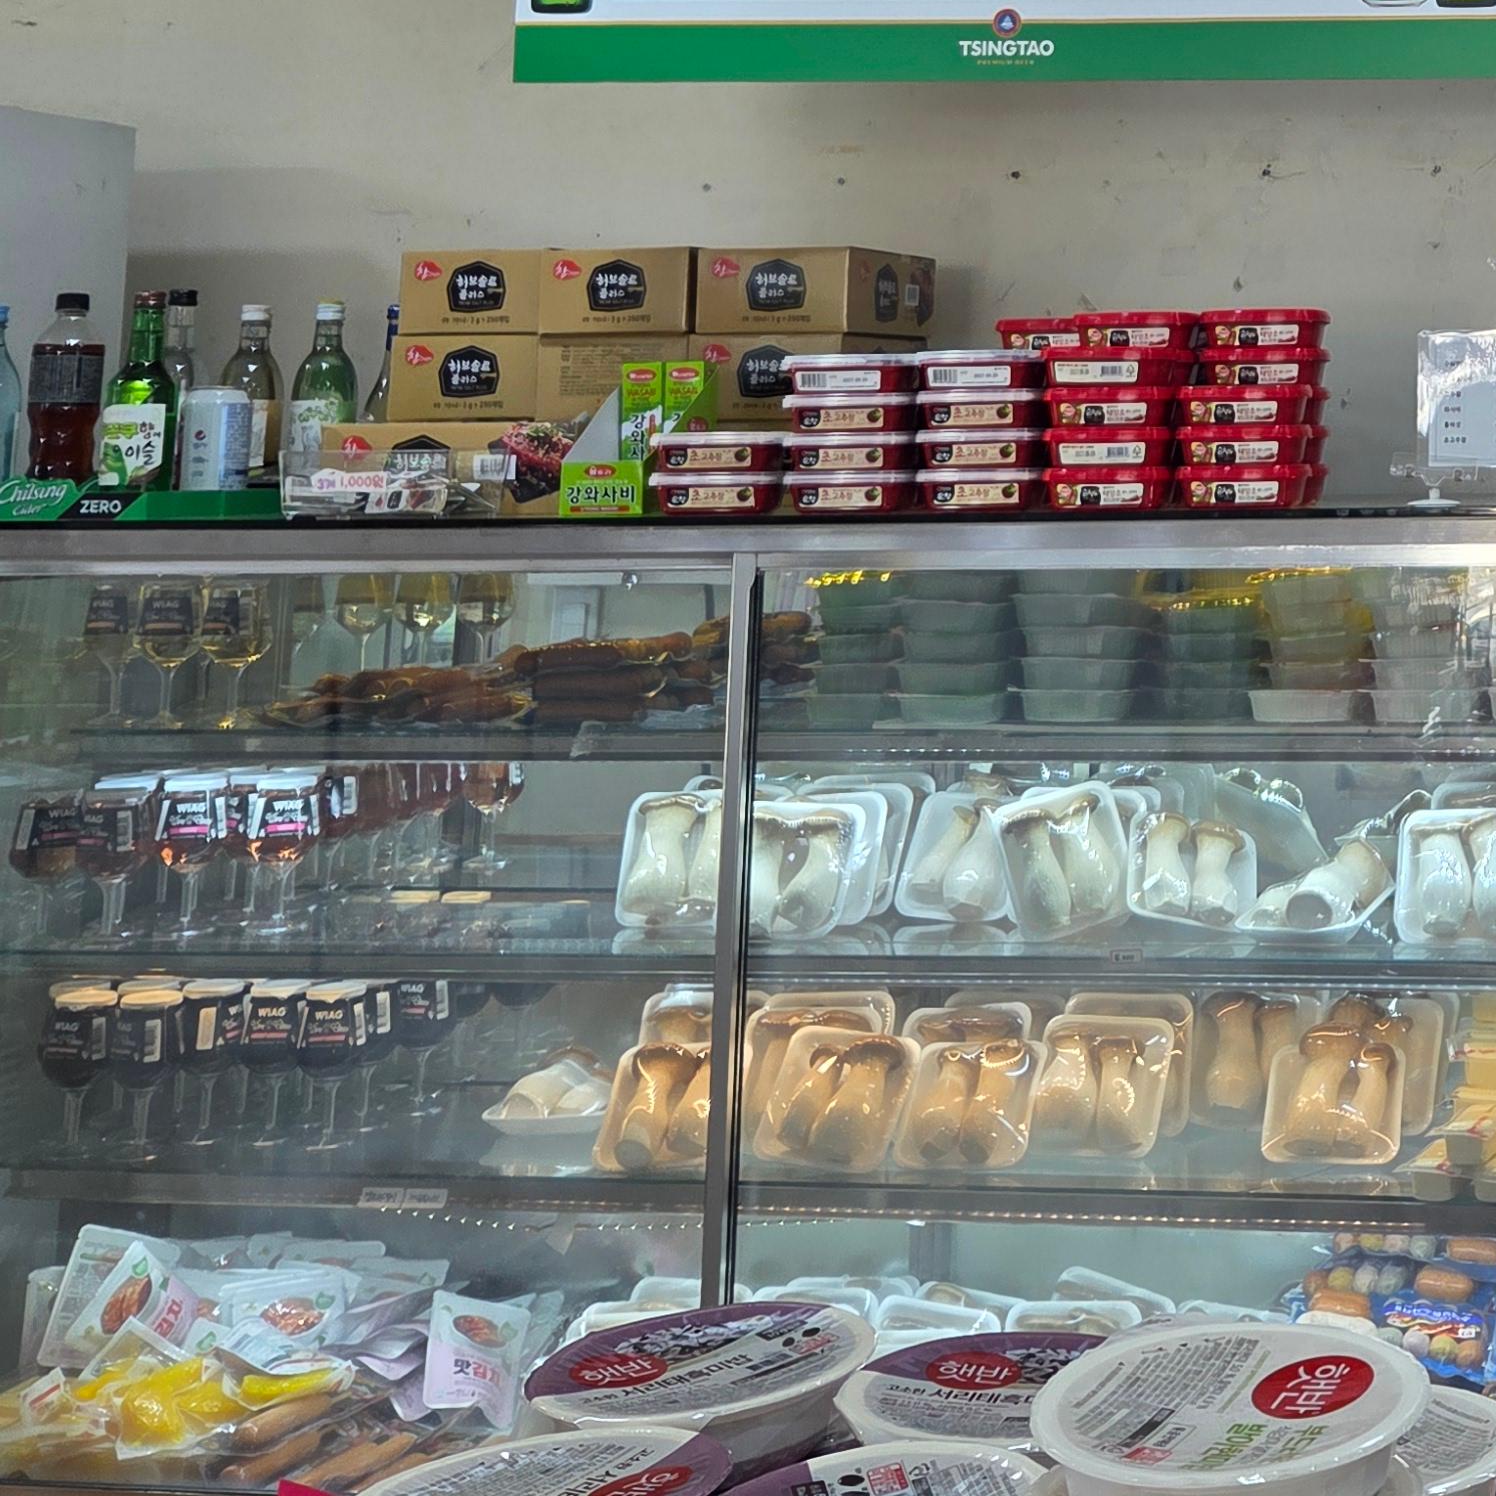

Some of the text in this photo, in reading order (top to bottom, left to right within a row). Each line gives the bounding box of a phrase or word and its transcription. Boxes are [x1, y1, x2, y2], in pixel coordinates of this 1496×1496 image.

[958, 40, 1055, 57] TSINGTAO
[566, 485, 636, 504] 강와사비
[79, 500, 122, 514] ZERO
[937, 1360, 1013, 1385] 햇반
